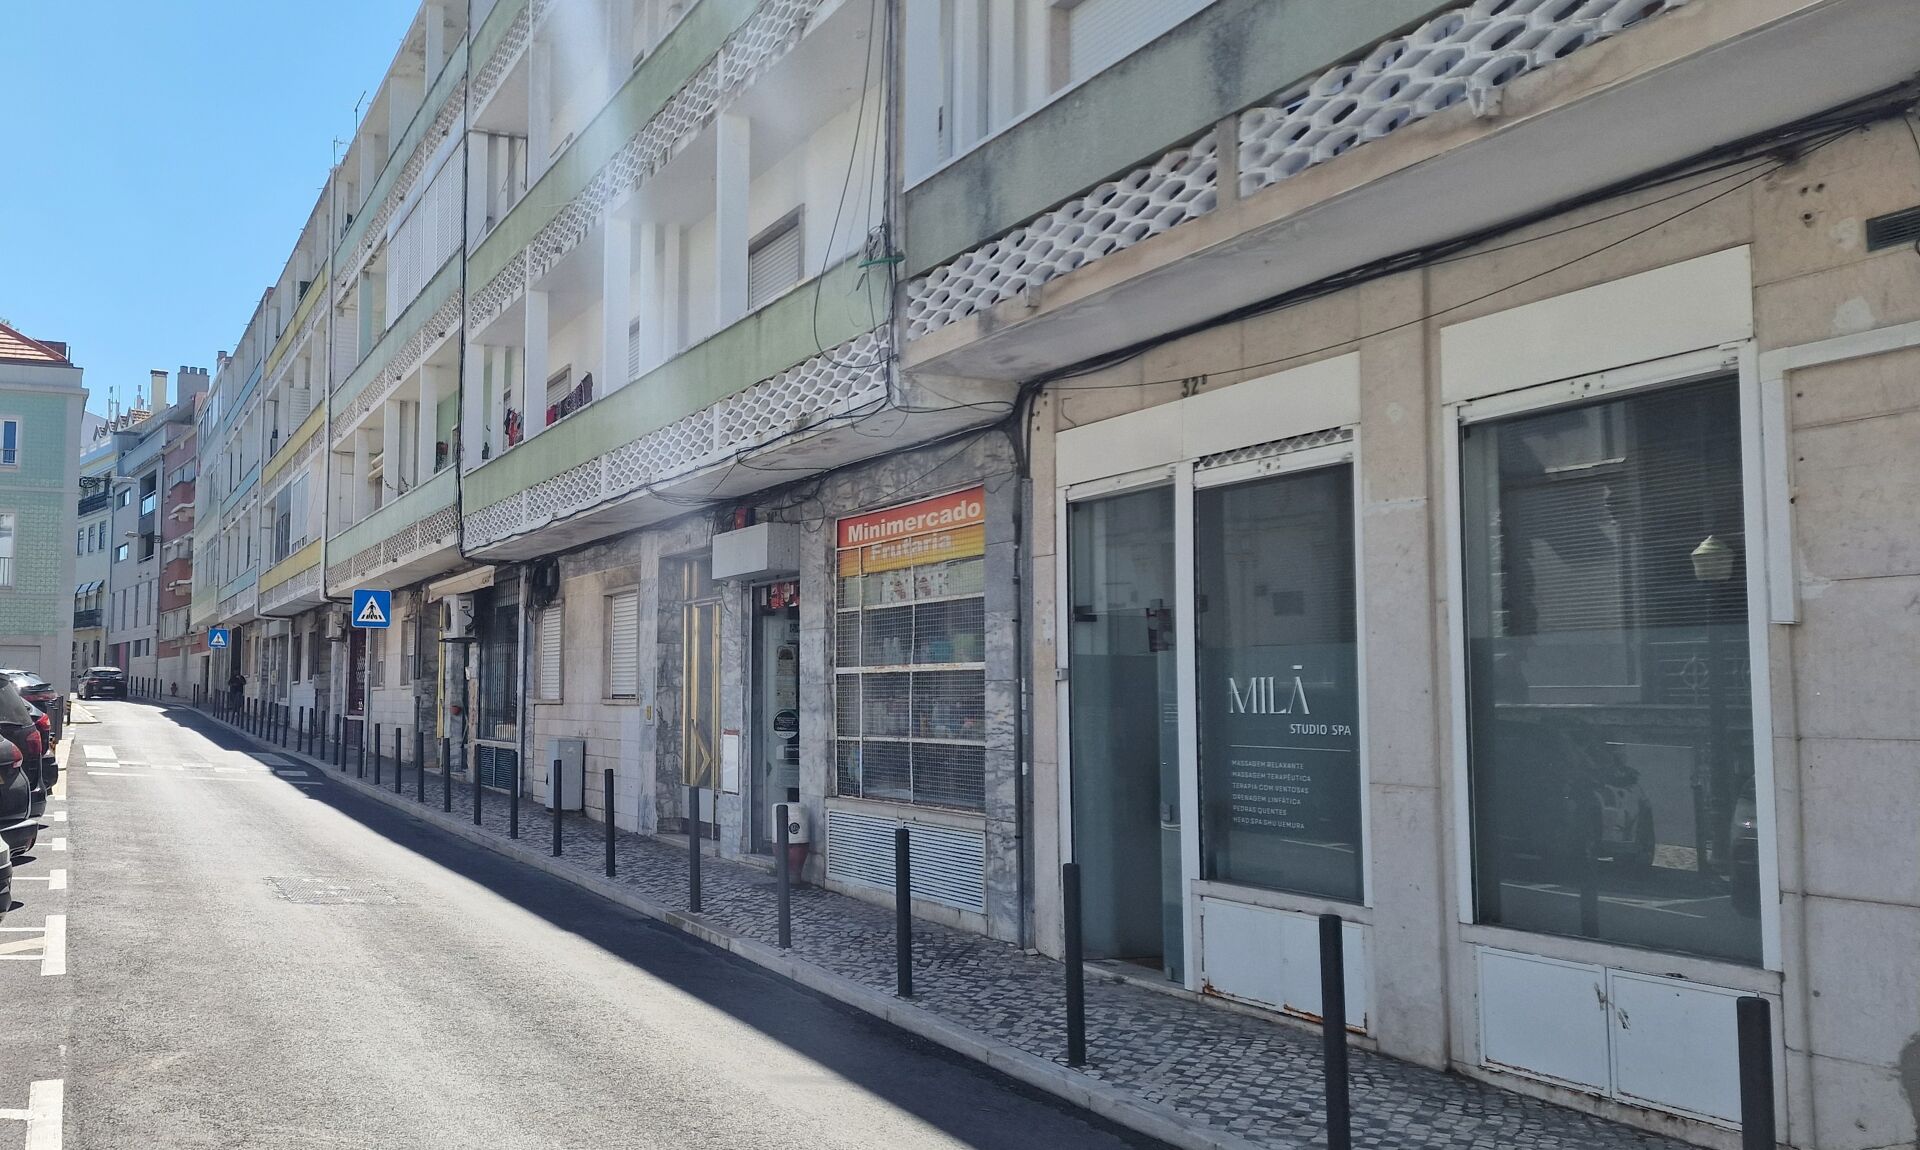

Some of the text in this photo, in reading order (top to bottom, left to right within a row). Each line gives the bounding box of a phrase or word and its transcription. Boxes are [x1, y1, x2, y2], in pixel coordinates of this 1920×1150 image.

[847, 500, 981, 543] Minimercado
[869, 533, 951, 561] Frutaria
[1290, 723, 1352, 736] STUDIO SPA
[1232, 760, 1304, 770] MASSAGEM RELAXANTE
[1232, 771, 1266, 779] MASSAGEM
[1257, 807, 1287, 816] QUENTES
